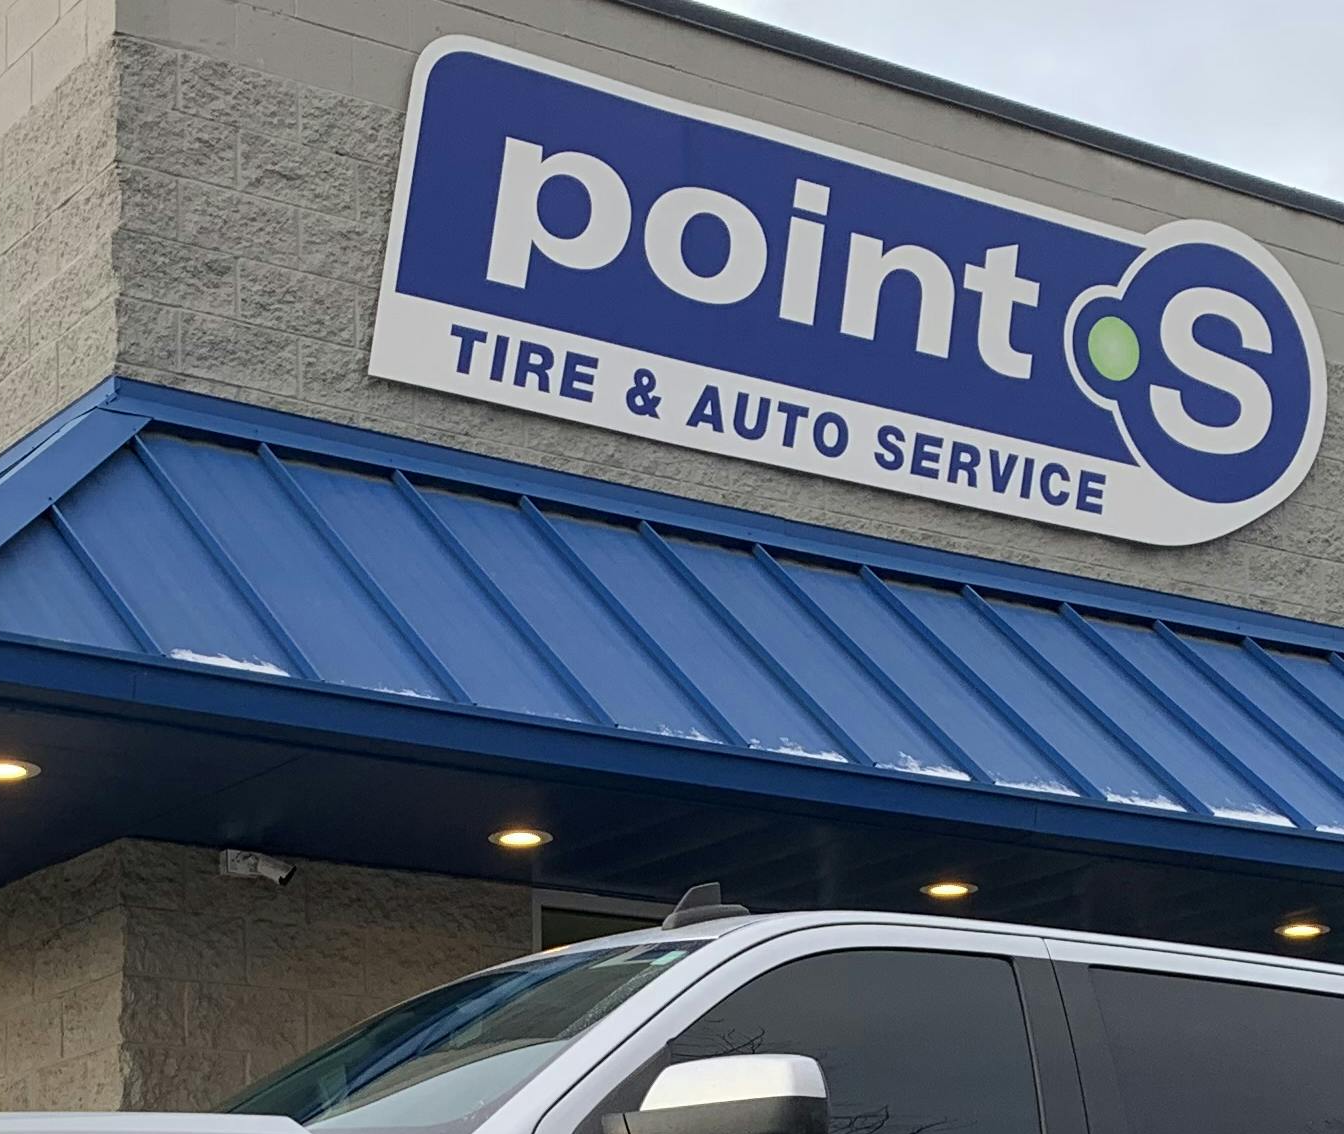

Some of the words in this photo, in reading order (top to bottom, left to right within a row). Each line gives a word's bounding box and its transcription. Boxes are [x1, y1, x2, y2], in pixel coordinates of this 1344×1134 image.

[449, 323, 599, 404] TIRE
[625, 368, 662, 420] &
[685, 384, 850, 458] AUTO
[873, 424, 1107, 515] SERVICE
[485, 135, 1041, 380] point
[1149, 286, 1274, 456] S
